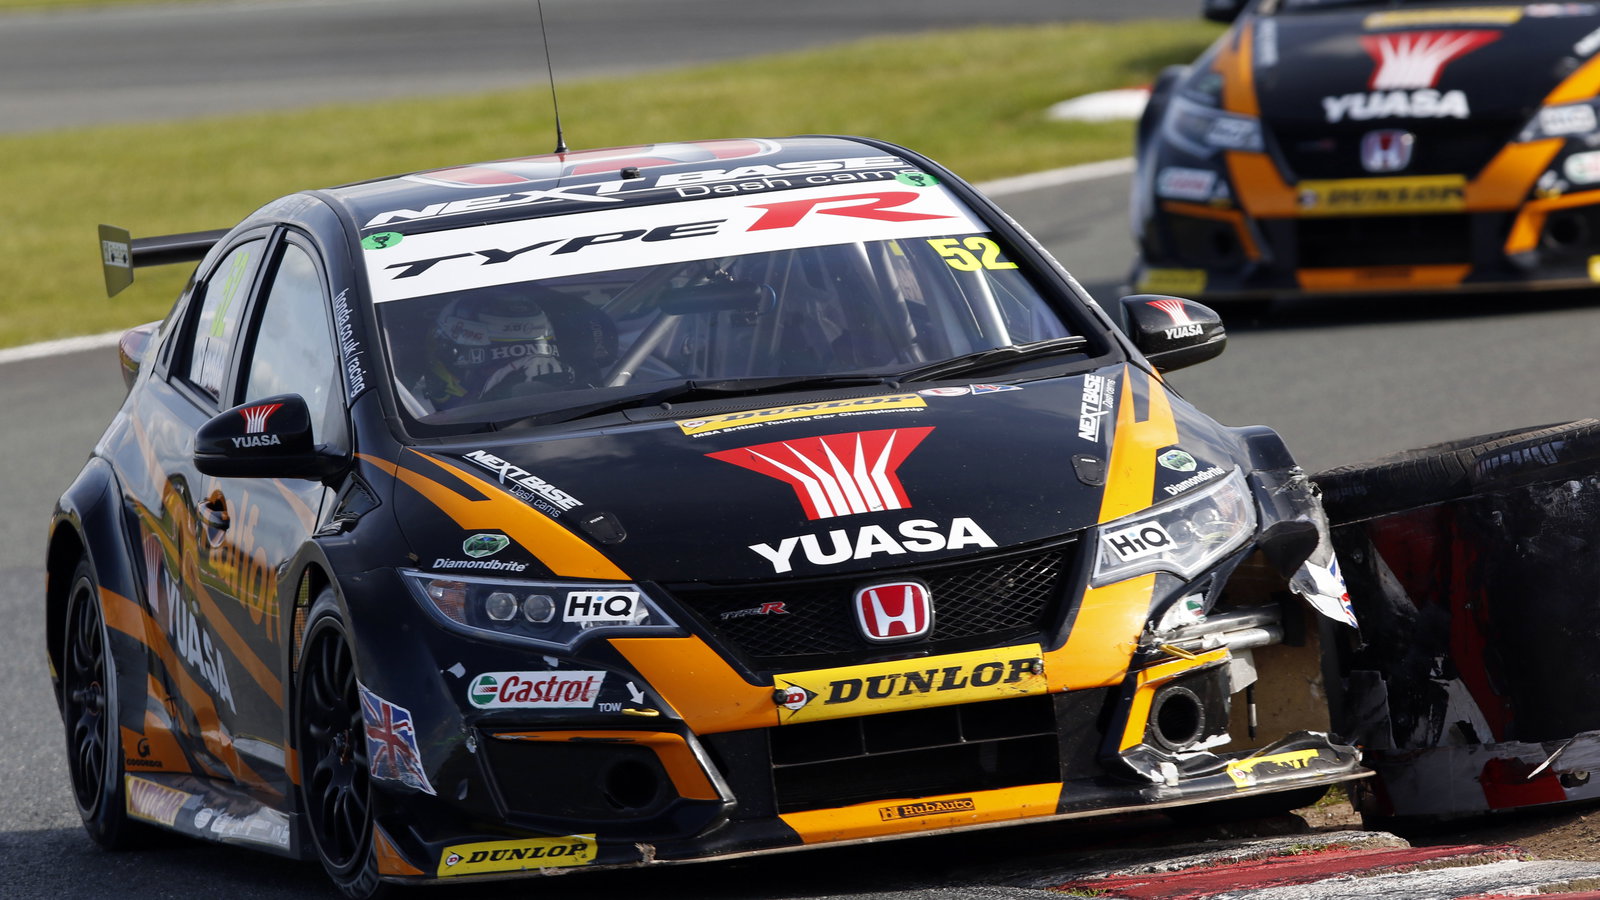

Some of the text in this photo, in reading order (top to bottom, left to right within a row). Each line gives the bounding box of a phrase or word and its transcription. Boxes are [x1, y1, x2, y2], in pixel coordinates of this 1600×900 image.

[1321, 88, 1471, 123] YUASA
[675, 170, 793, 198] Dash
[383, 190, 961, 281] TYPE R
[926, 236, 1019, 272] 52
[334, 287, 367, 399] honda.co.uk/racing
[1164, 324, 1204, 340] YUASA
[491, 344, 560, 360] HONDA
[692, 430, 722, 439] MSA
[722, 423, 763, 433] British
[764, 416, 811, 426] Touring
[838, 406, 925, 417] Championship
[721, 395, 918, 423] DUNLOP
[231, 434, 281, 449] YUASA
[1163, 465, 1226, 496] Diamondbrite
[509, 485, 562, 519] Dash cams
[747, 516, 999, 574] YUASA
[1108, 527, 1171, 557] HiQ
[432, 558, 527, 572] Diamondbrite
[567, 595, 632, 617] HiQ
[164, 567, 237, 716] YUASA
[499, 675, 594, 703] Castrol
[823, 656, 1042, 706] DUNLOP
[597, 702, 623, 712] TOW
[903, 799, 974, 816] HubAuto
[465, 843, 589, 864] DUNLOP
